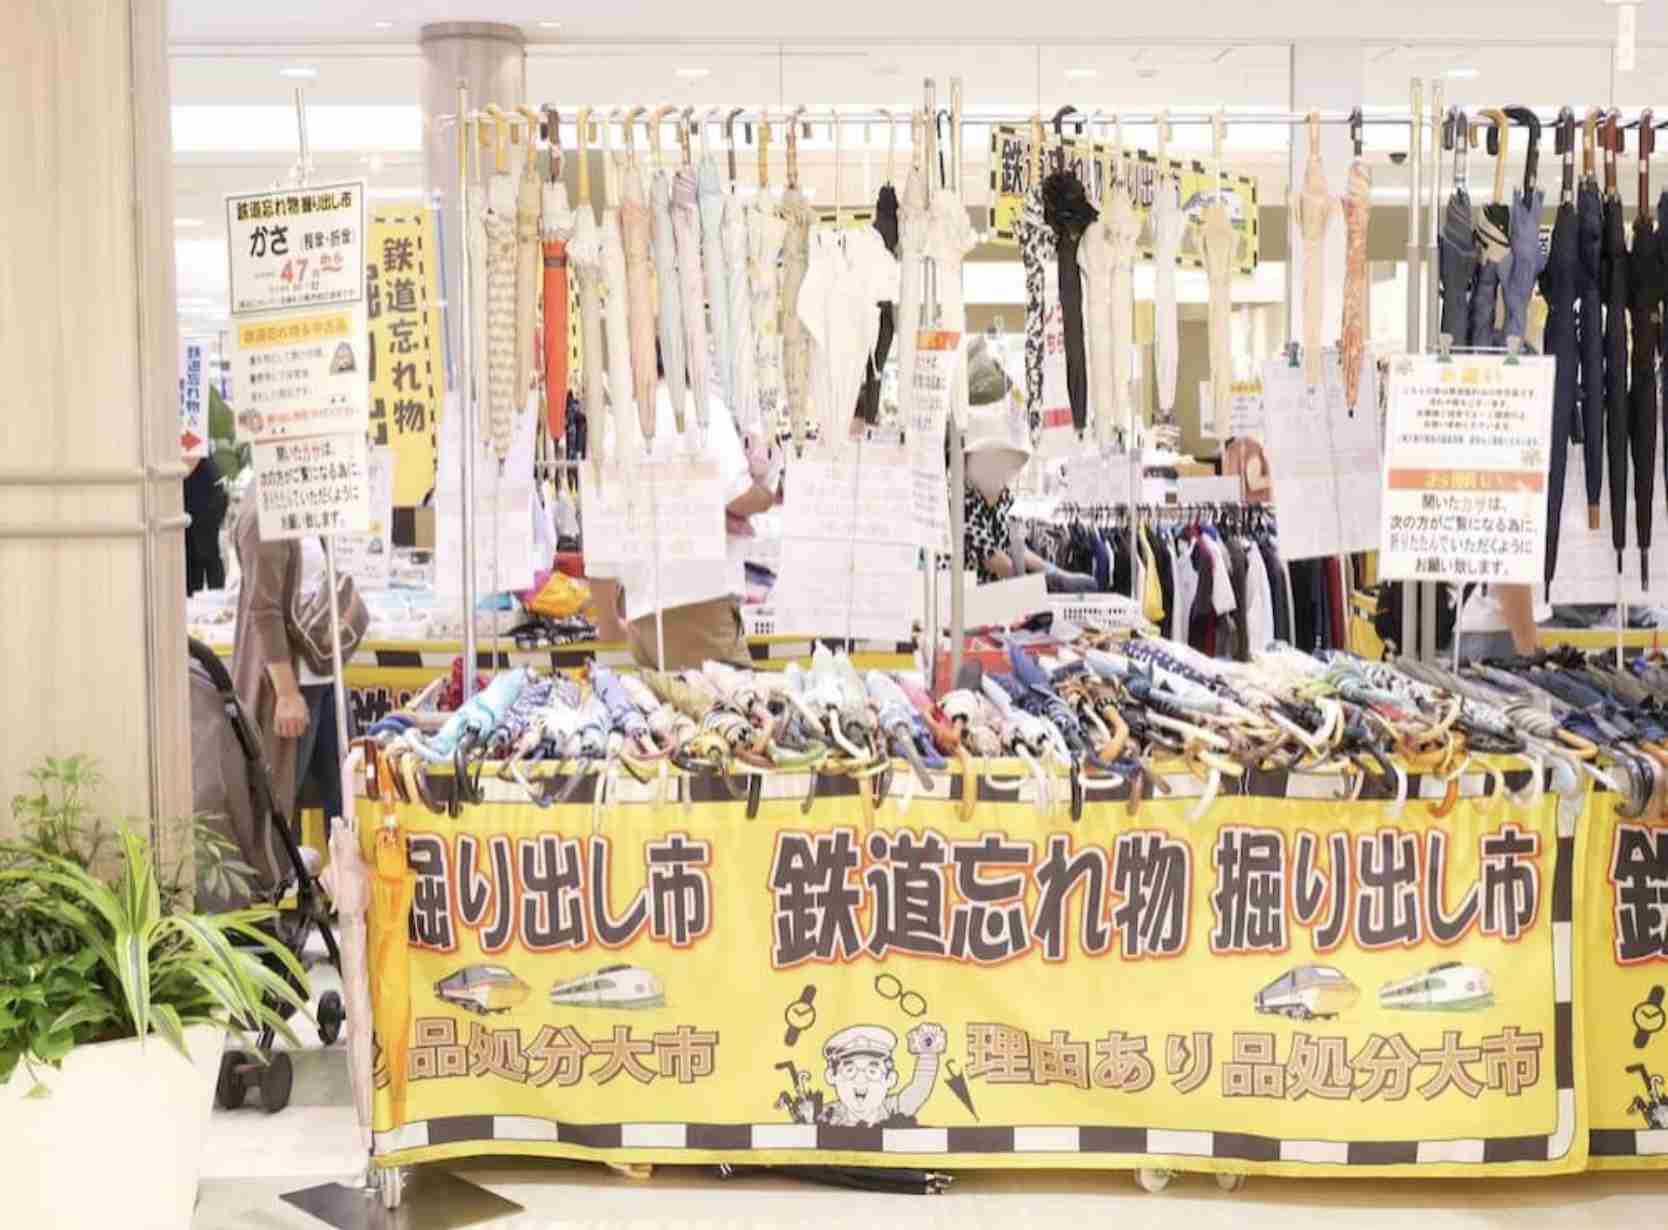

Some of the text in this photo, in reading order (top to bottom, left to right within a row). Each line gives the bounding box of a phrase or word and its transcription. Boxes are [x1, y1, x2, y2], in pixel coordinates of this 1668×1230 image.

[250, 225, 289, 258] かさ
[280, 257, 308, 284] 47
[383, 237, 426, 433] 鉄道忘れ物
[1390, 515, 1537, 533] 次の方がご覧になる為に、
[1415, 557, 1510, 576] お願い致します。
[407, 832, 715, 954] 掘り出し市
[769, 822, 1543, 969] 鉄道忘れ物 掘り出し市
[372, 1017, 720, 1090] 品処分大市
[965, 1022, 1543, 1102] 理由あり品処分大市
